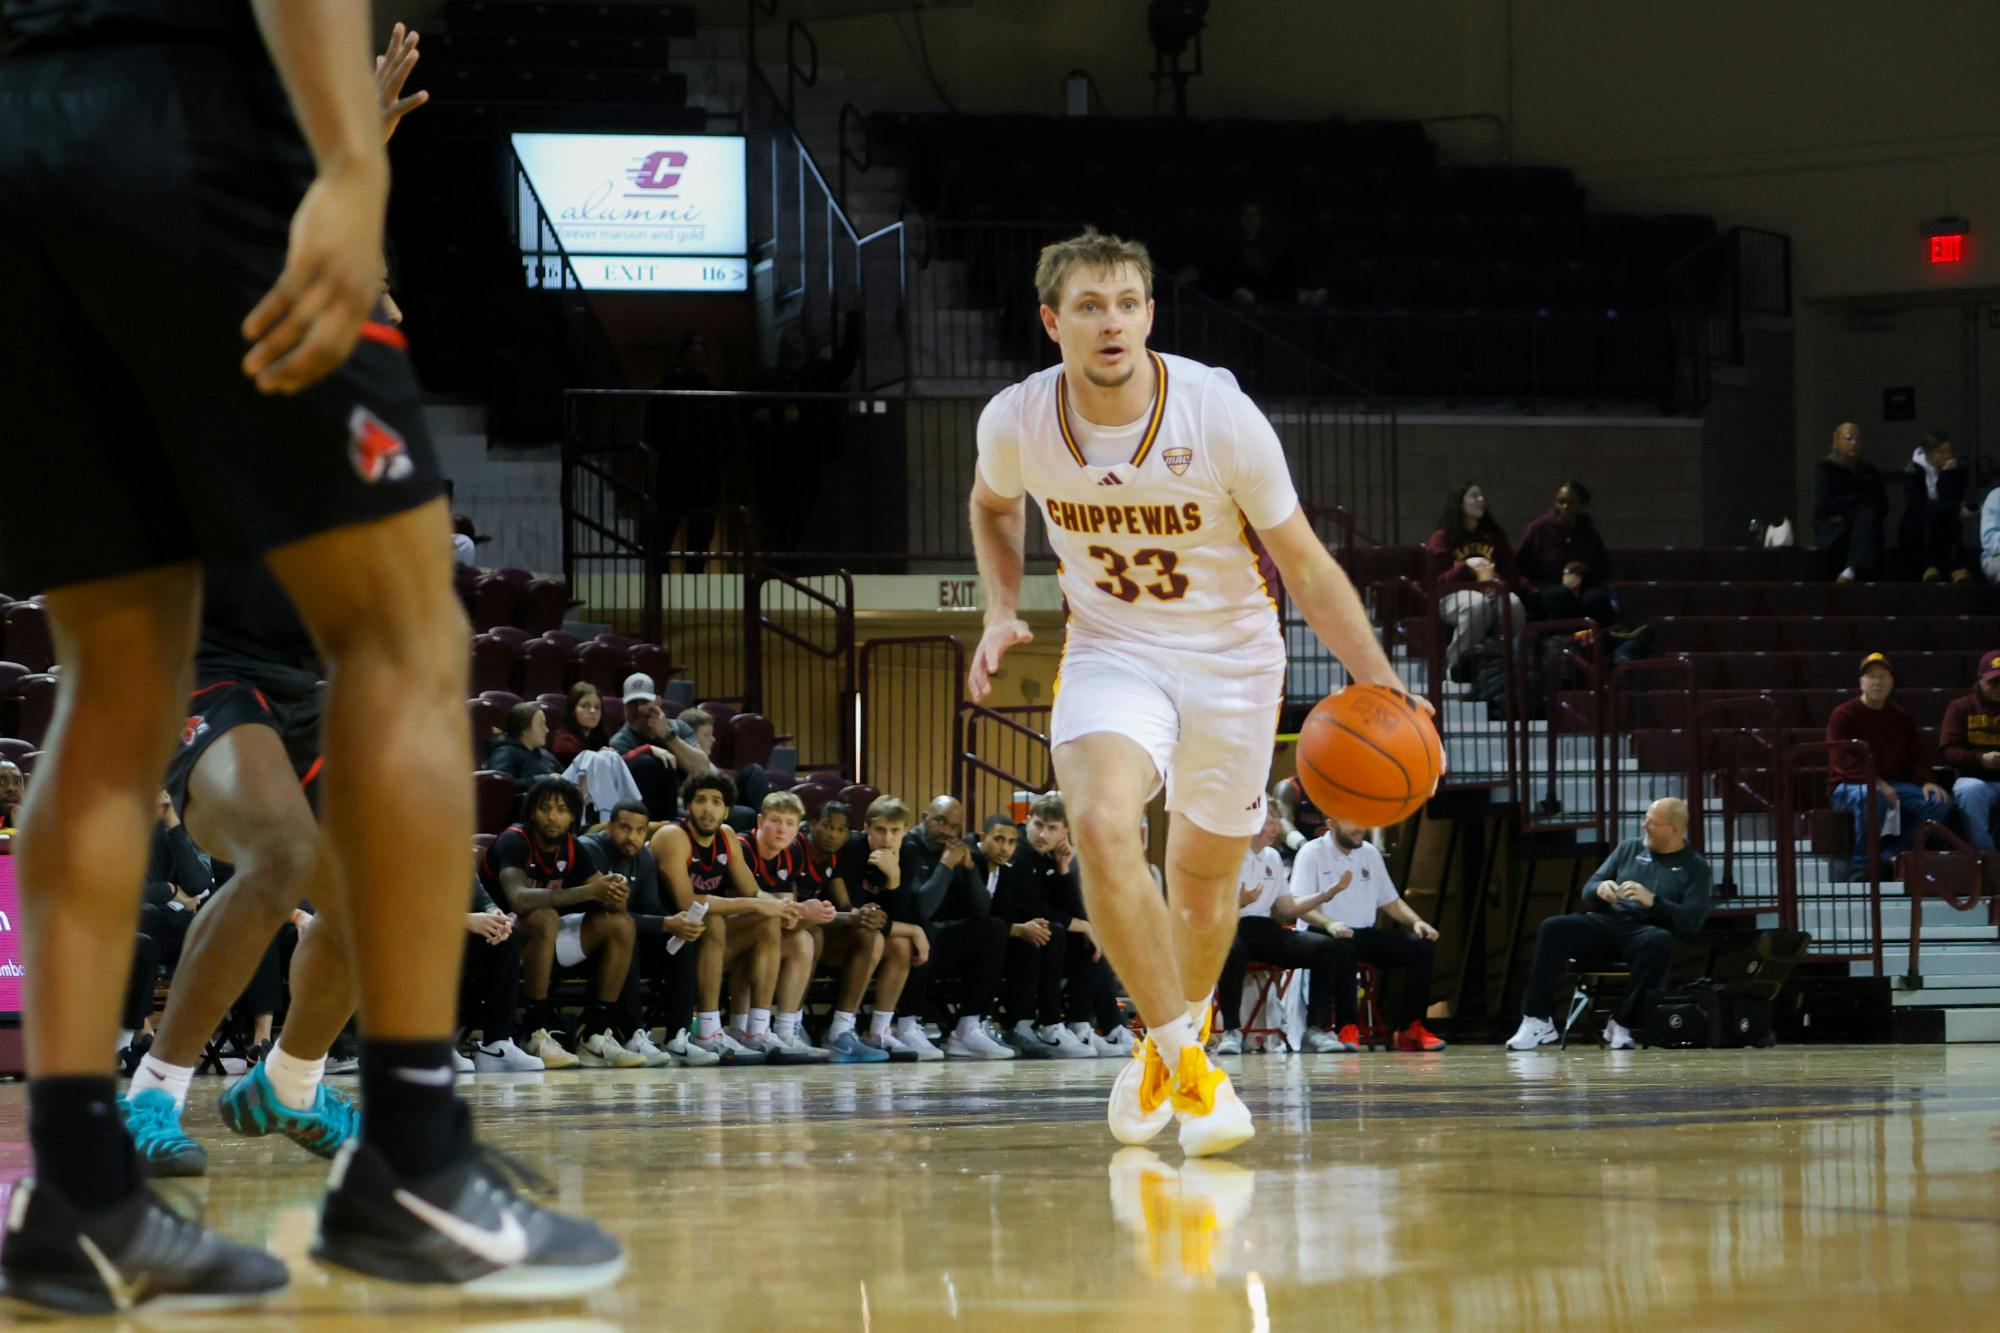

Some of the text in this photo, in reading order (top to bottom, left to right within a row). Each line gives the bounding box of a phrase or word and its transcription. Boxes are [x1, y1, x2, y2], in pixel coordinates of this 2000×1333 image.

[561, 180, 702, 222] alumni
[600, 229, 648, 240] maroon
[651, 229, 673, 240] and
[677, 229, 705, 243] gold
[605, 265, 660, 281] EXIT
[1046, 498, 1202, 535] CHIPPEWAS
[1088, 545, 1189, 603] 33
[939, 580, 976, 607] EXIT
